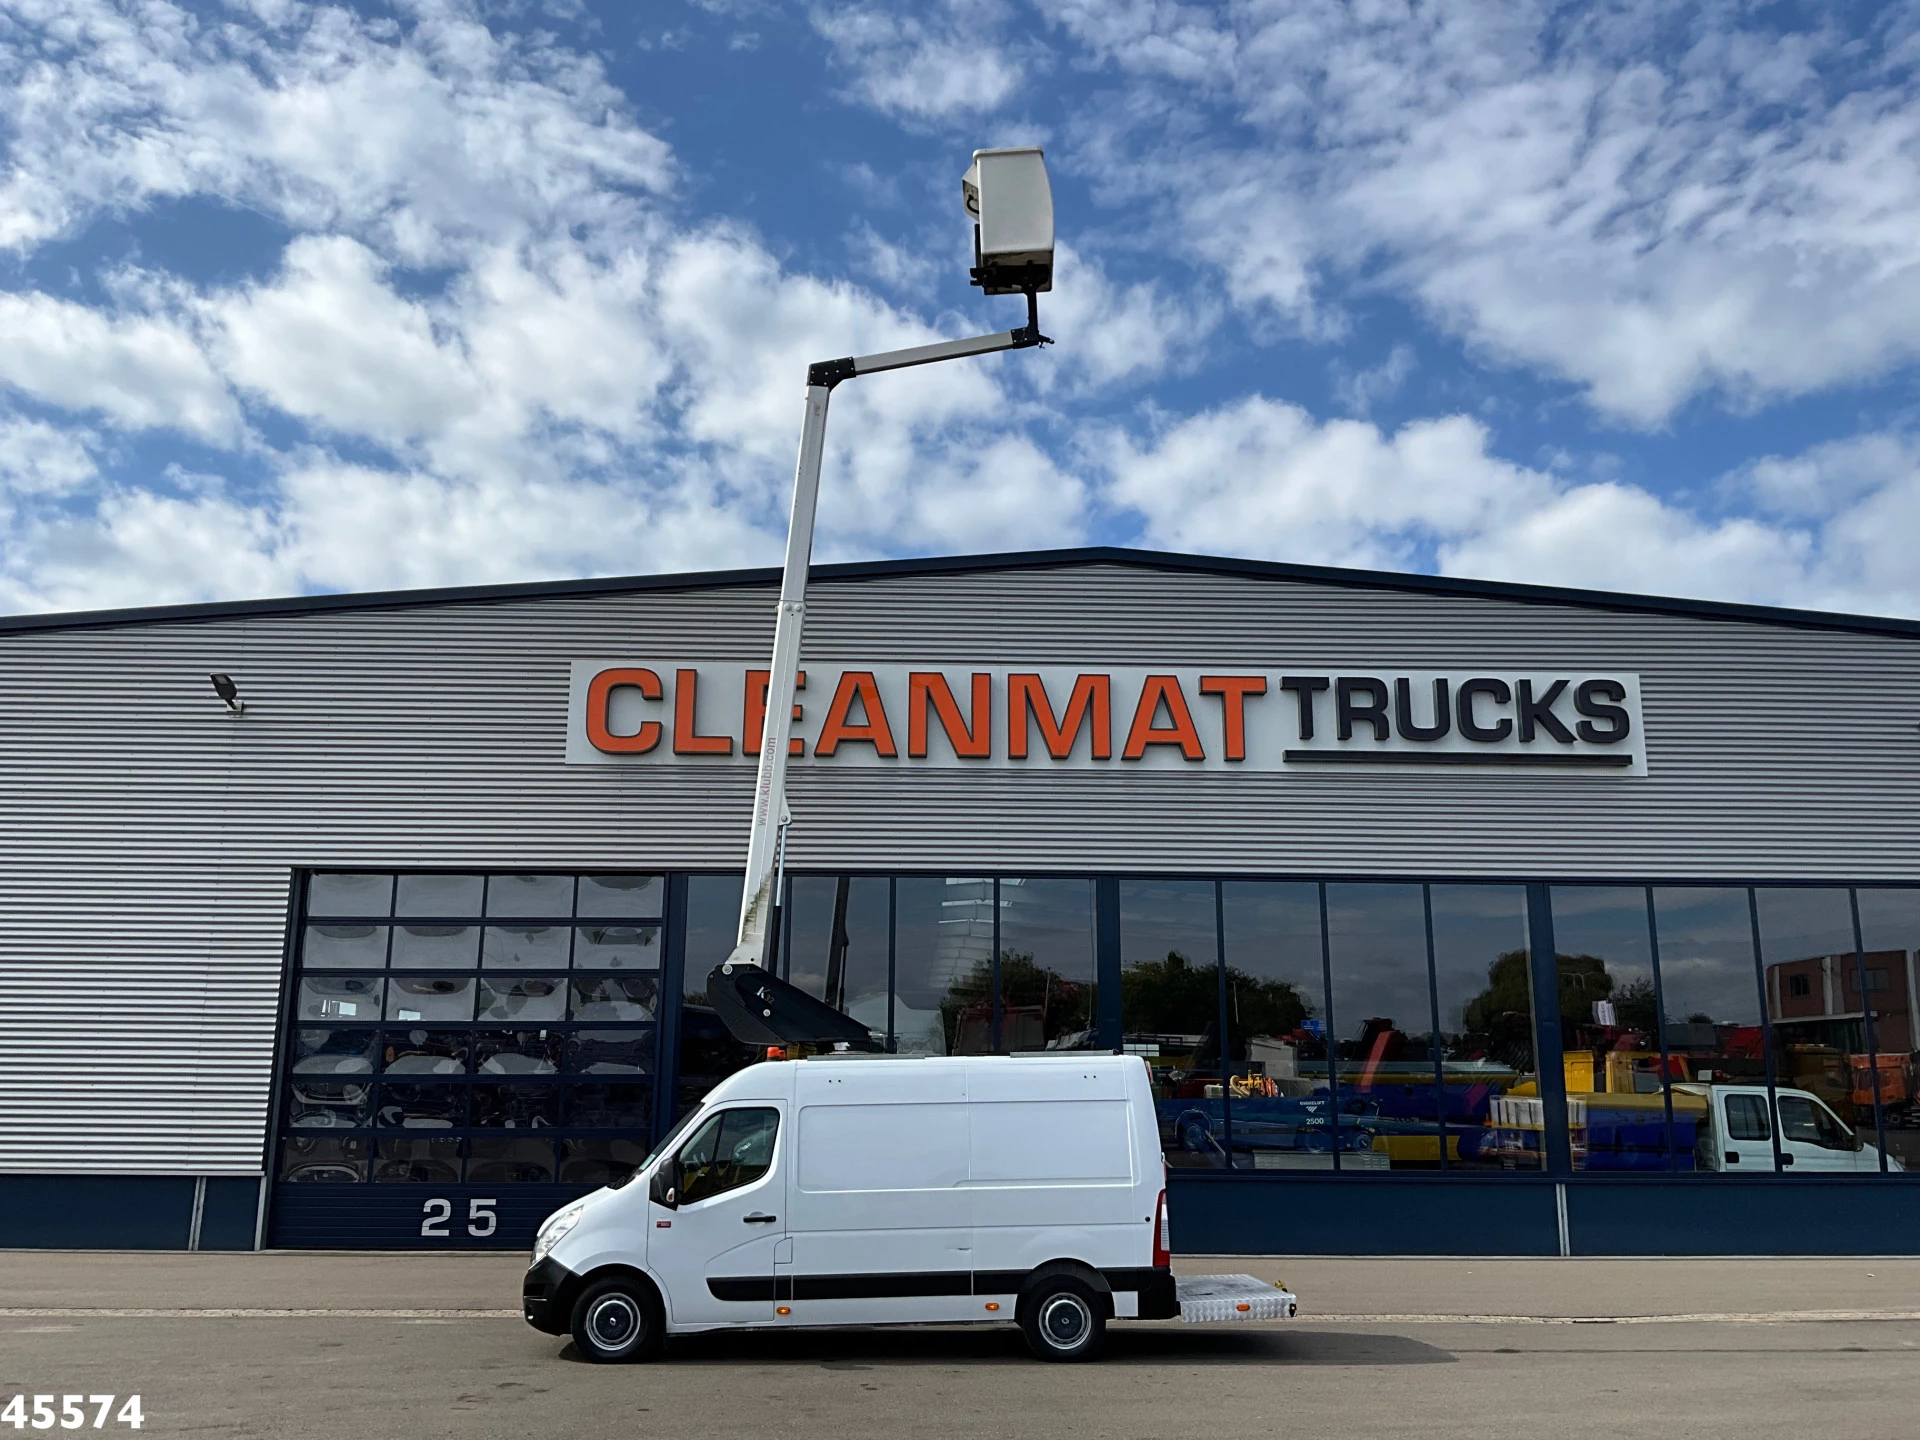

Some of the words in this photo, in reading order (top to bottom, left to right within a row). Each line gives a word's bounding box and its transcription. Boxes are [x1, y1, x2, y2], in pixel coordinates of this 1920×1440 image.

[586, 667, 1267, 761] CLEANMAT
[1280, 676, 1630, 744] TRUCKS
[758, 737, 776, 826] www.klubb.com
[1306, 1117, 1325, 1125] 2500
